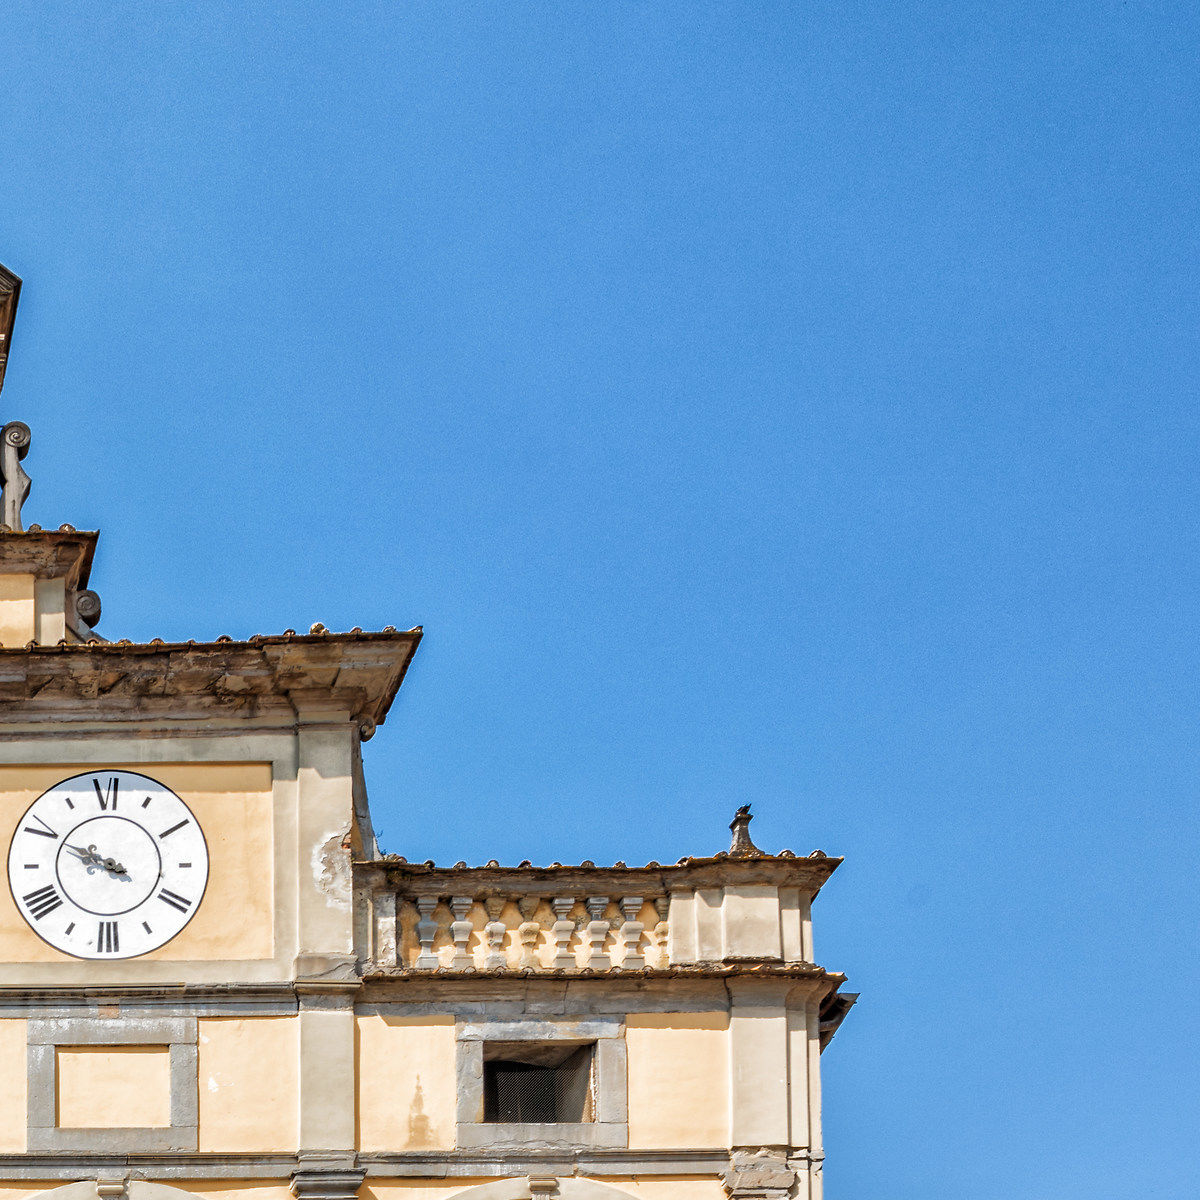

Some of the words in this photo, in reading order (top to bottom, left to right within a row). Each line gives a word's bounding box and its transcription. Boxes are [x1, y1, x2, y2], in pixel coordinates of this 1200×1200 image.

[92, 777, 120, 811] VI
[23, 814, 60, 840] V
[158, 818, 190, 839] I
[22, 883, 65, 922] IIII
[156, 888, 193, 914] II
[96, 921, 120, 953] III
